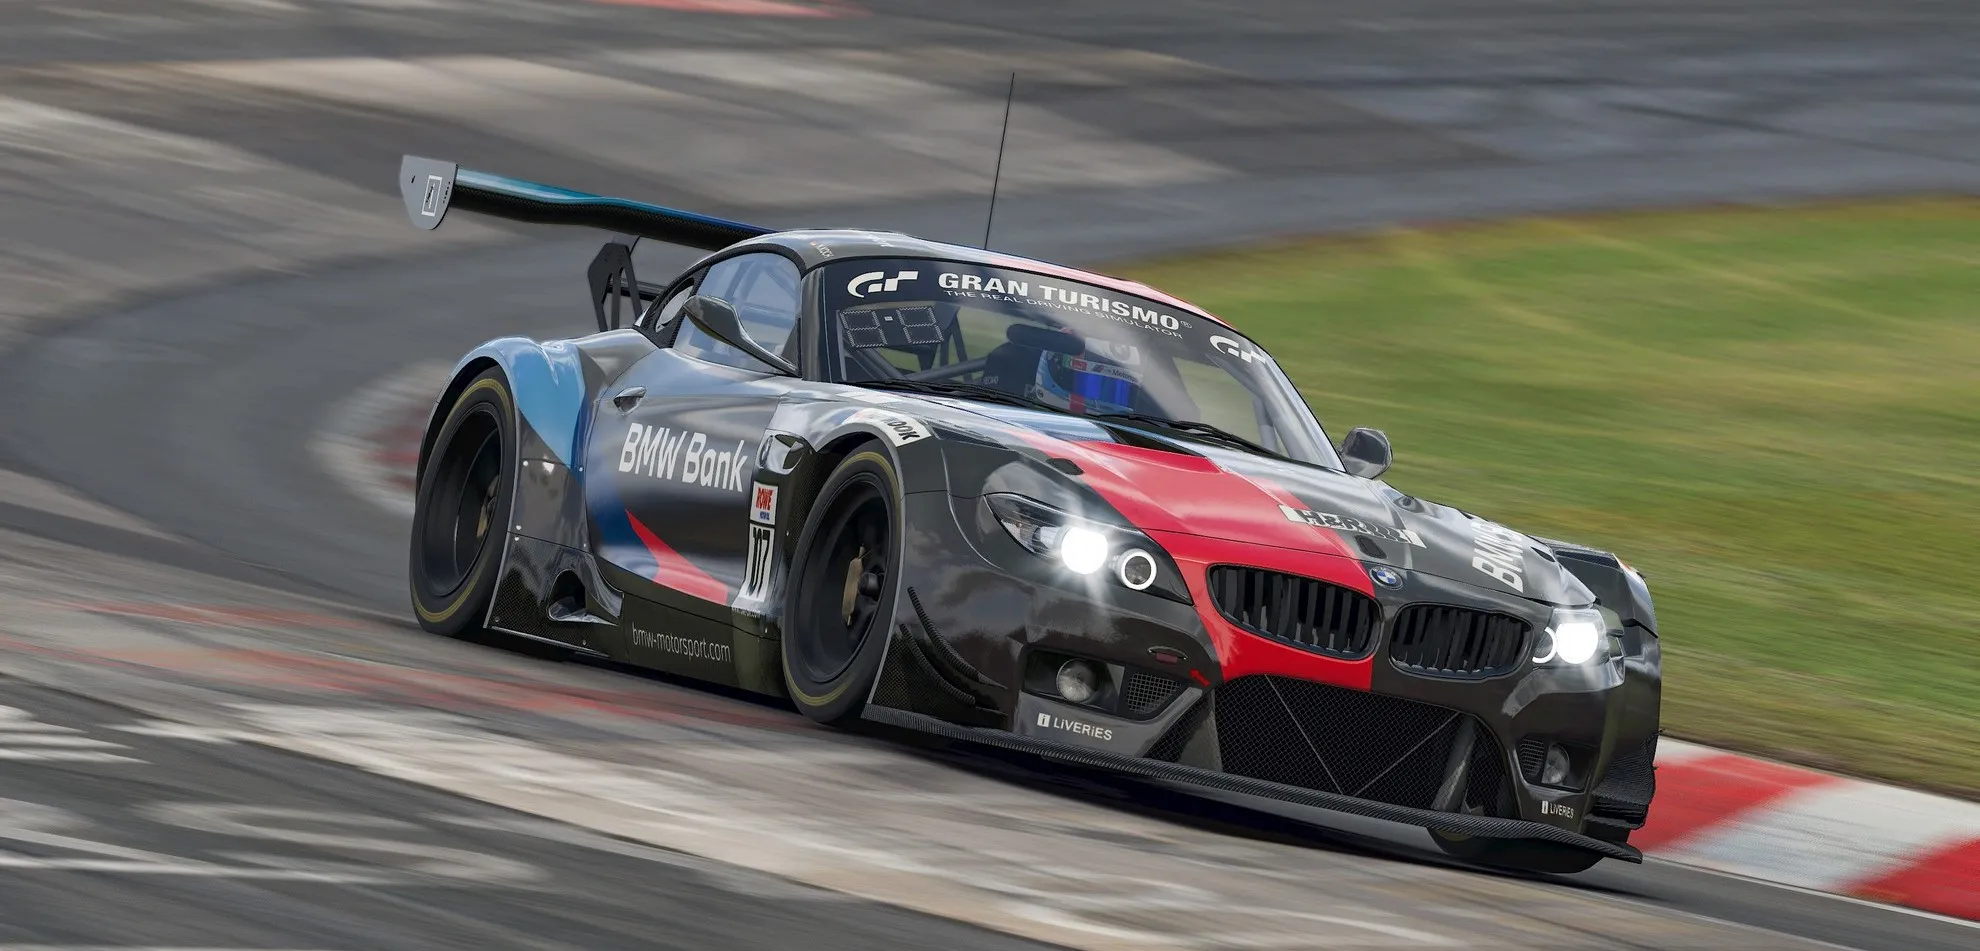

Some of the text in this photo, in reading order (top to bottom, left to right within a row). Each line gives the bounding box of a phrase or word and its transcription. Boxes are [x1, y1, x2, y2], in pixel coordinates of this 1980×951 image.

[938, 272, 1029, 297] GRAN
[944, 290, 1184, 339] THE REAL DRIVING SIMULATOR
[618, 422, 748, 492] BMW Bank
[1472, 528, 1524, 594] BMW
[632, 621, 732, 662] bmw-motorsport.com
